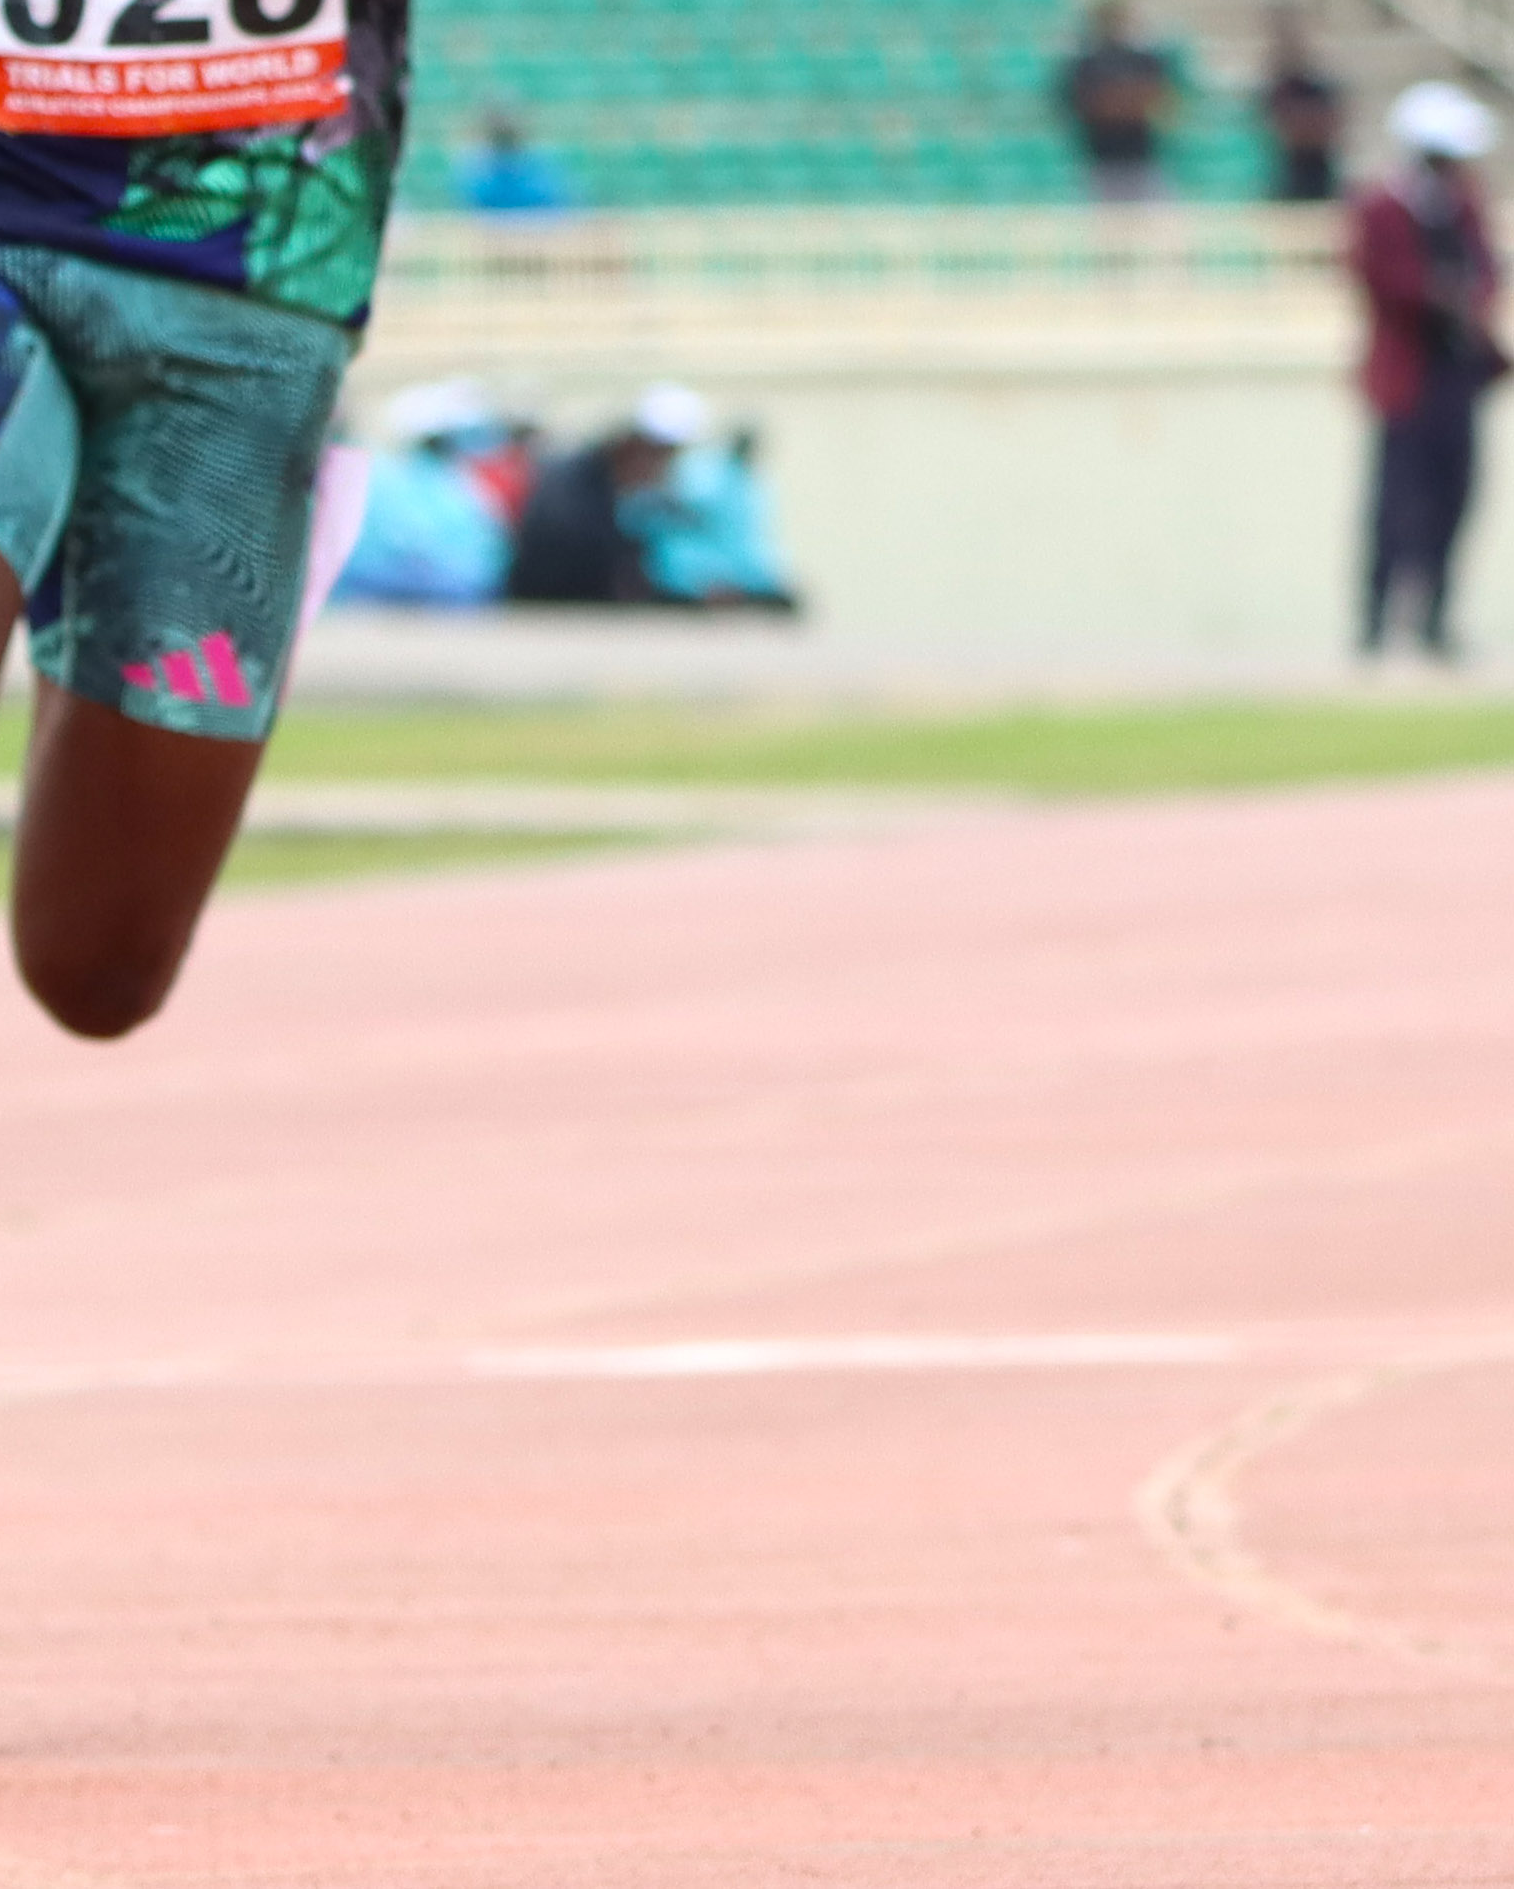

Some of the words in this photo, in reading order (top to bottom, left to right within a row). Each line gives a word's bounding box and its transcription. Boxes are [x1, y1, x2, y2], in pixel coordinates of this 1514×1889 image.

[2, 59, 121, 94] TRIALS
[124, 60, 196, 95] FOR
[198, 47, 320, 90] WORLD
